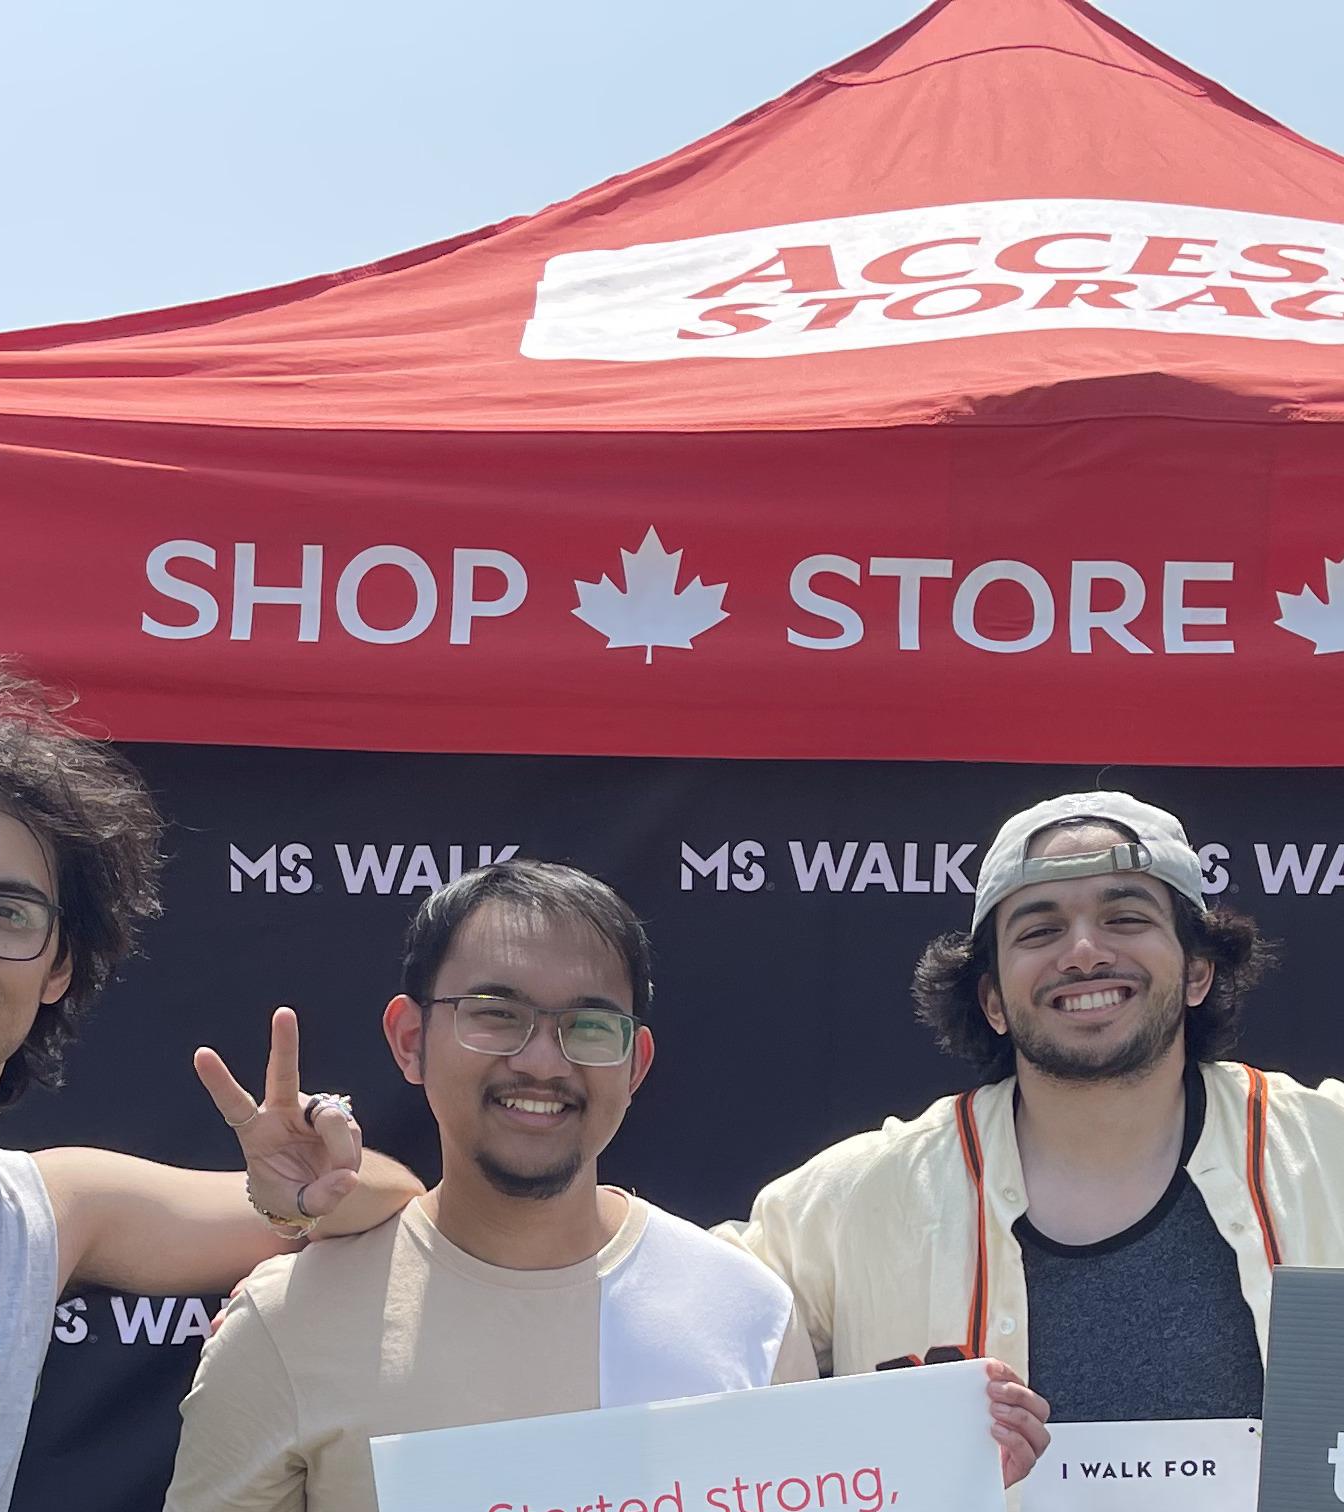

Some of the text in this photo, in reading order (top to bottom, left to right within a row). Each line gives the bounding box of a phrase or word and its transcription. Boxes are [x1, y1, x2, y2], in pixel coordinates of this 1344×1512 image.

[140, 538, 530, 646] SHOP
[786, 554, 1236, 656] STORE
[229, 842, 314, 894] MS
[679, 840, 766, 893] MS
[1062, 1459, 1217, 1480] I WALK FOR
